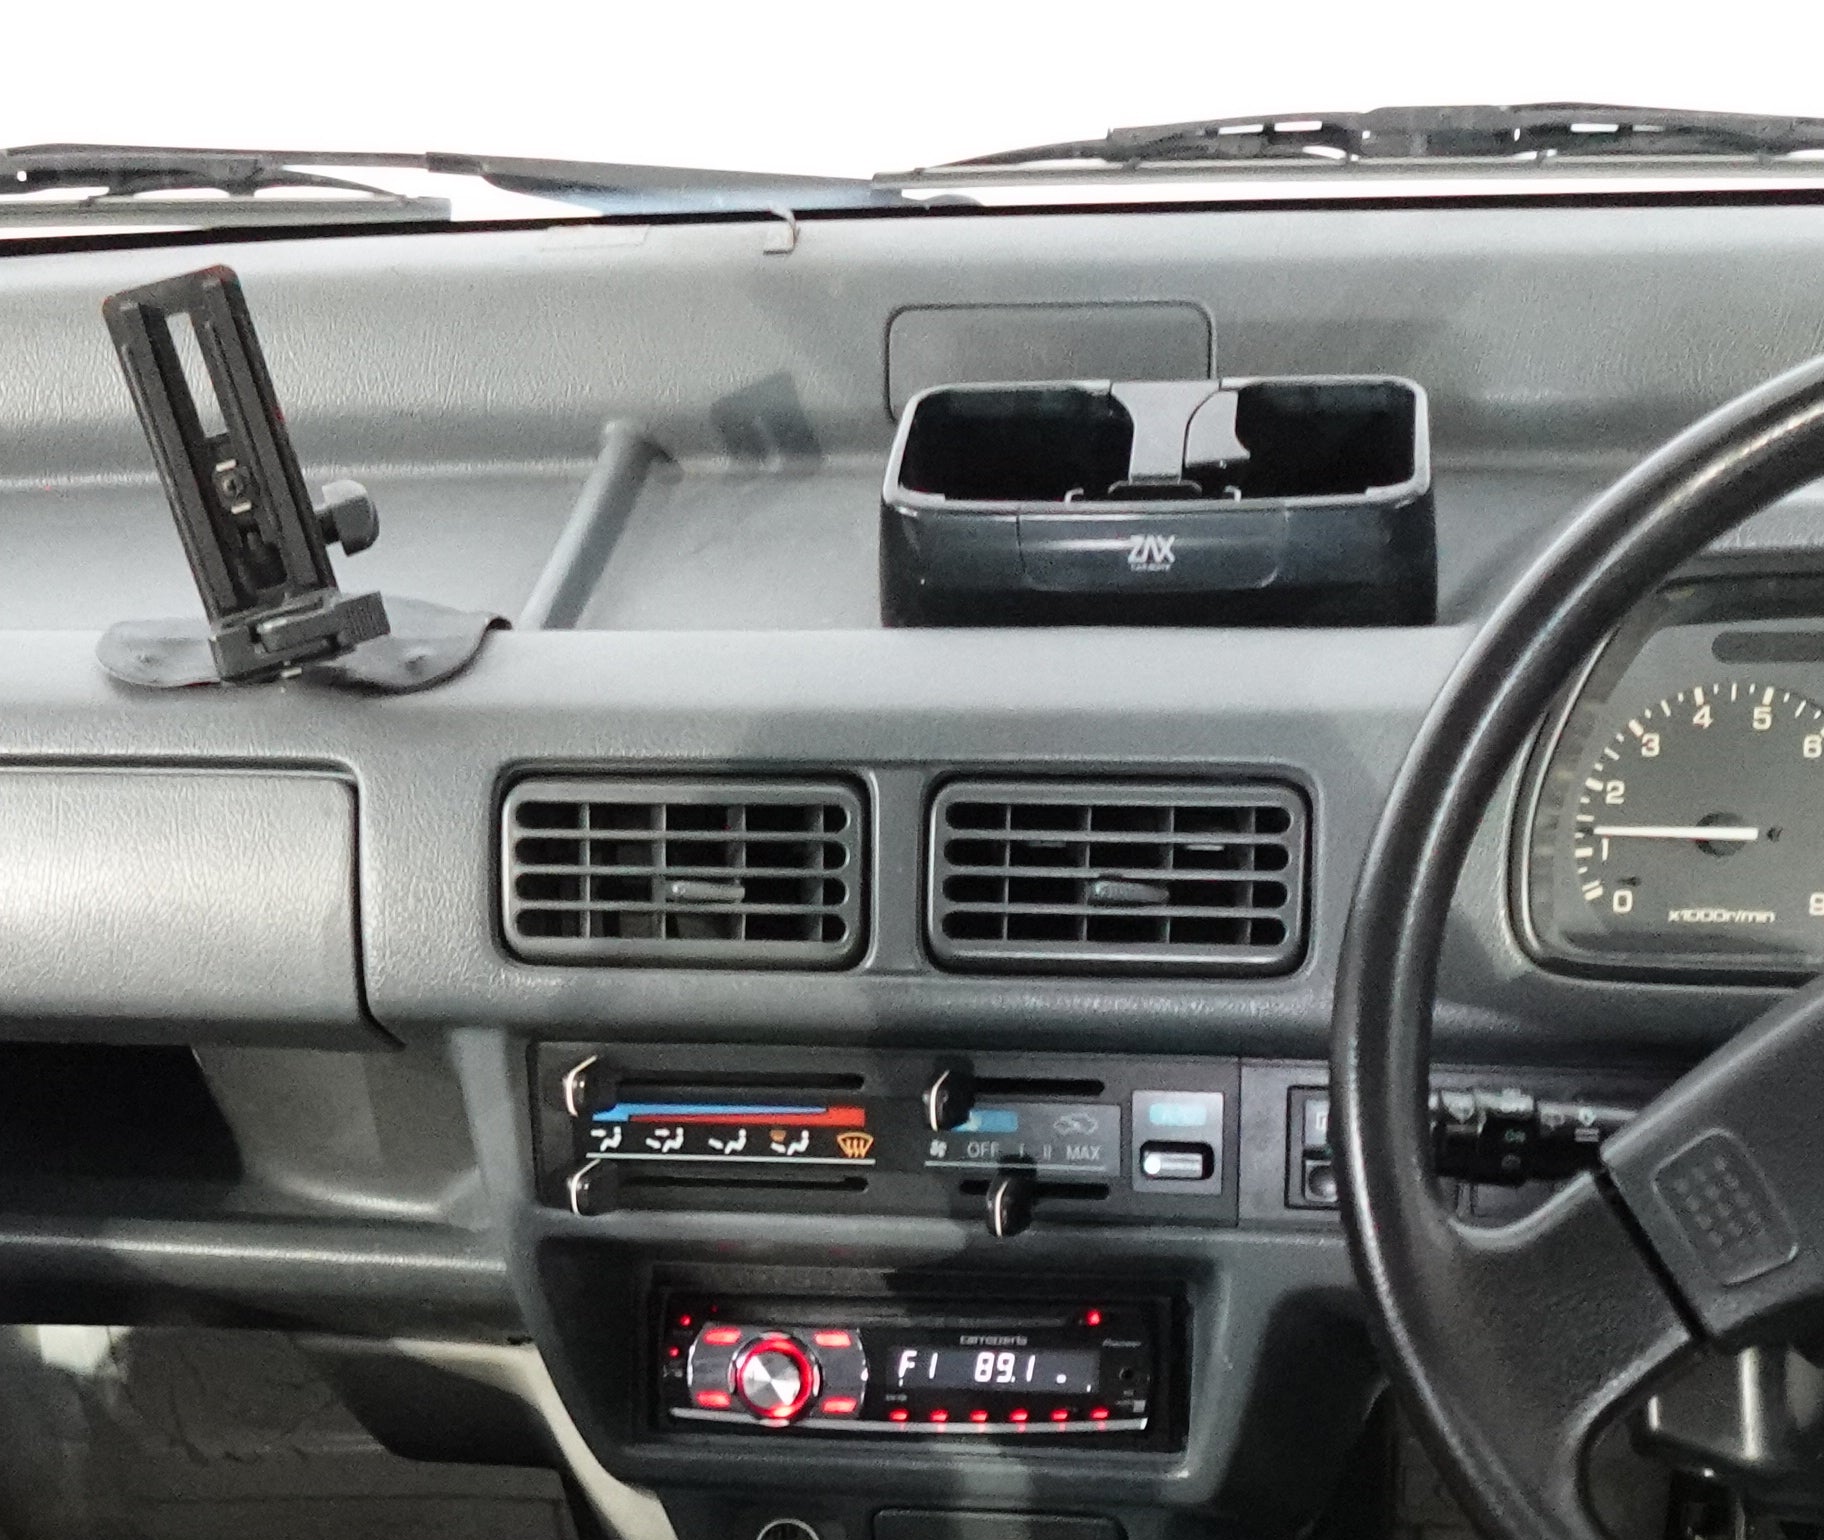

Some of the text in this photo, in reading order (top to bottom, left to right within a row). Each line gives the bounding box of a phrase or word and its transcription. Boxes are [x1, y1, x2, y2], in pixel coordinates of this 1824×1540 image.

[1128, 534, 1176, 563] ZAX
[1692, 704, 1713, 729] 4
[1752, 706, 1772, 730] 5
[1641, 733, 1661, 757] 3
[1803, 734, 1823, 759] 6
[1605, 780, 1625, 804] 2
[1601, 837, 1610, 862] 1
[1612, 889, 1633, 913] 0
[966, 1141, 999, 1159] OFF
[1065, 1144, 1102, 1161] MAX
[973, 1351, 1036, 1383] 89.1
